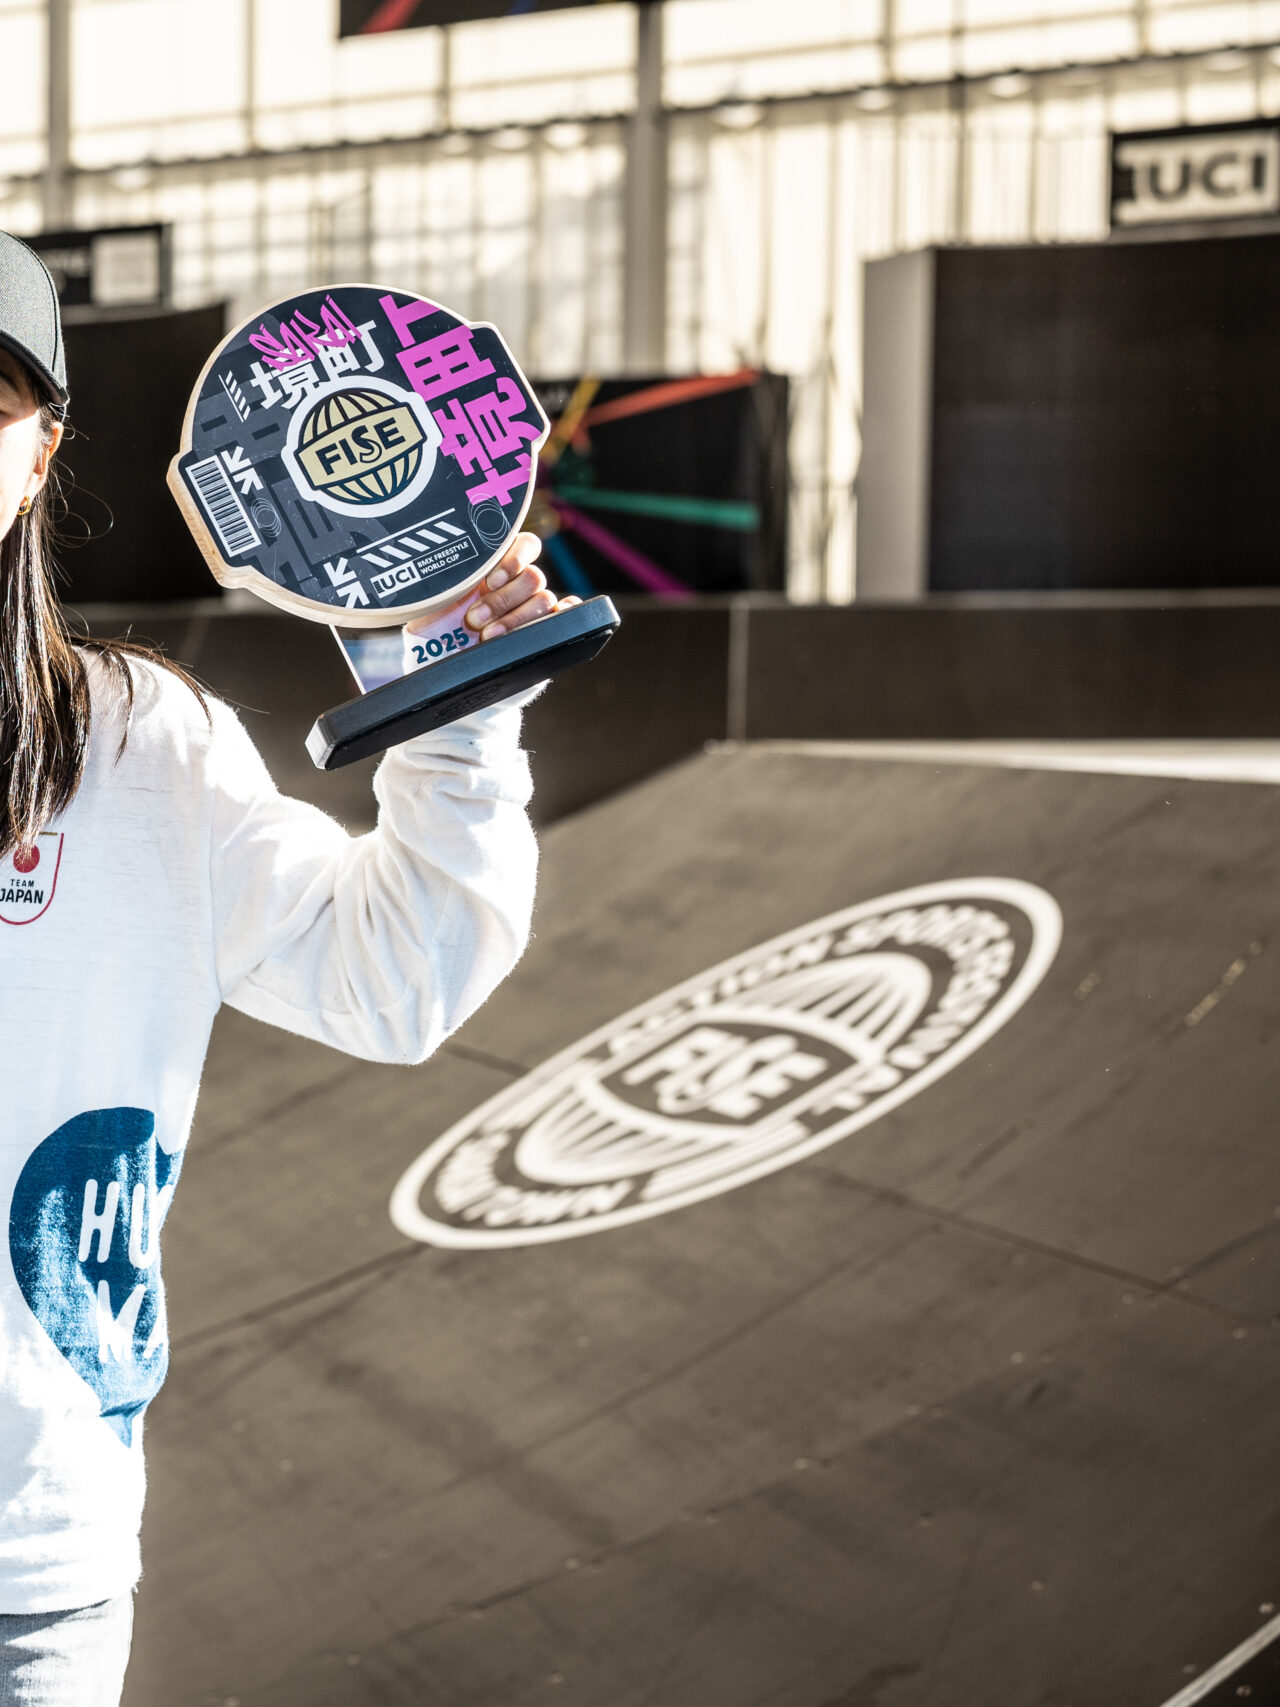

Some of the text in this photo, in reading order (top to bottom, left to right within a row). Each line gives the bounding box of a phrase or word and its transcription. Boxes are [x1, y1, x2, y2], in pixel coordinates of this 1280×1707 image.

[1147, 151, 1268, 204] UCI
[315, 416, 407, 476] FISE
[416, 541, 469, 569] BMX FREESTYLE
[420, 553, 460, 575] WORLD CUP
[380, 566, 417, 590] UCI
[411, 626, 470, 664] 2025
[10, 878, 35, 888] TEAM
[623, 1027, 828, 1120] FISE
